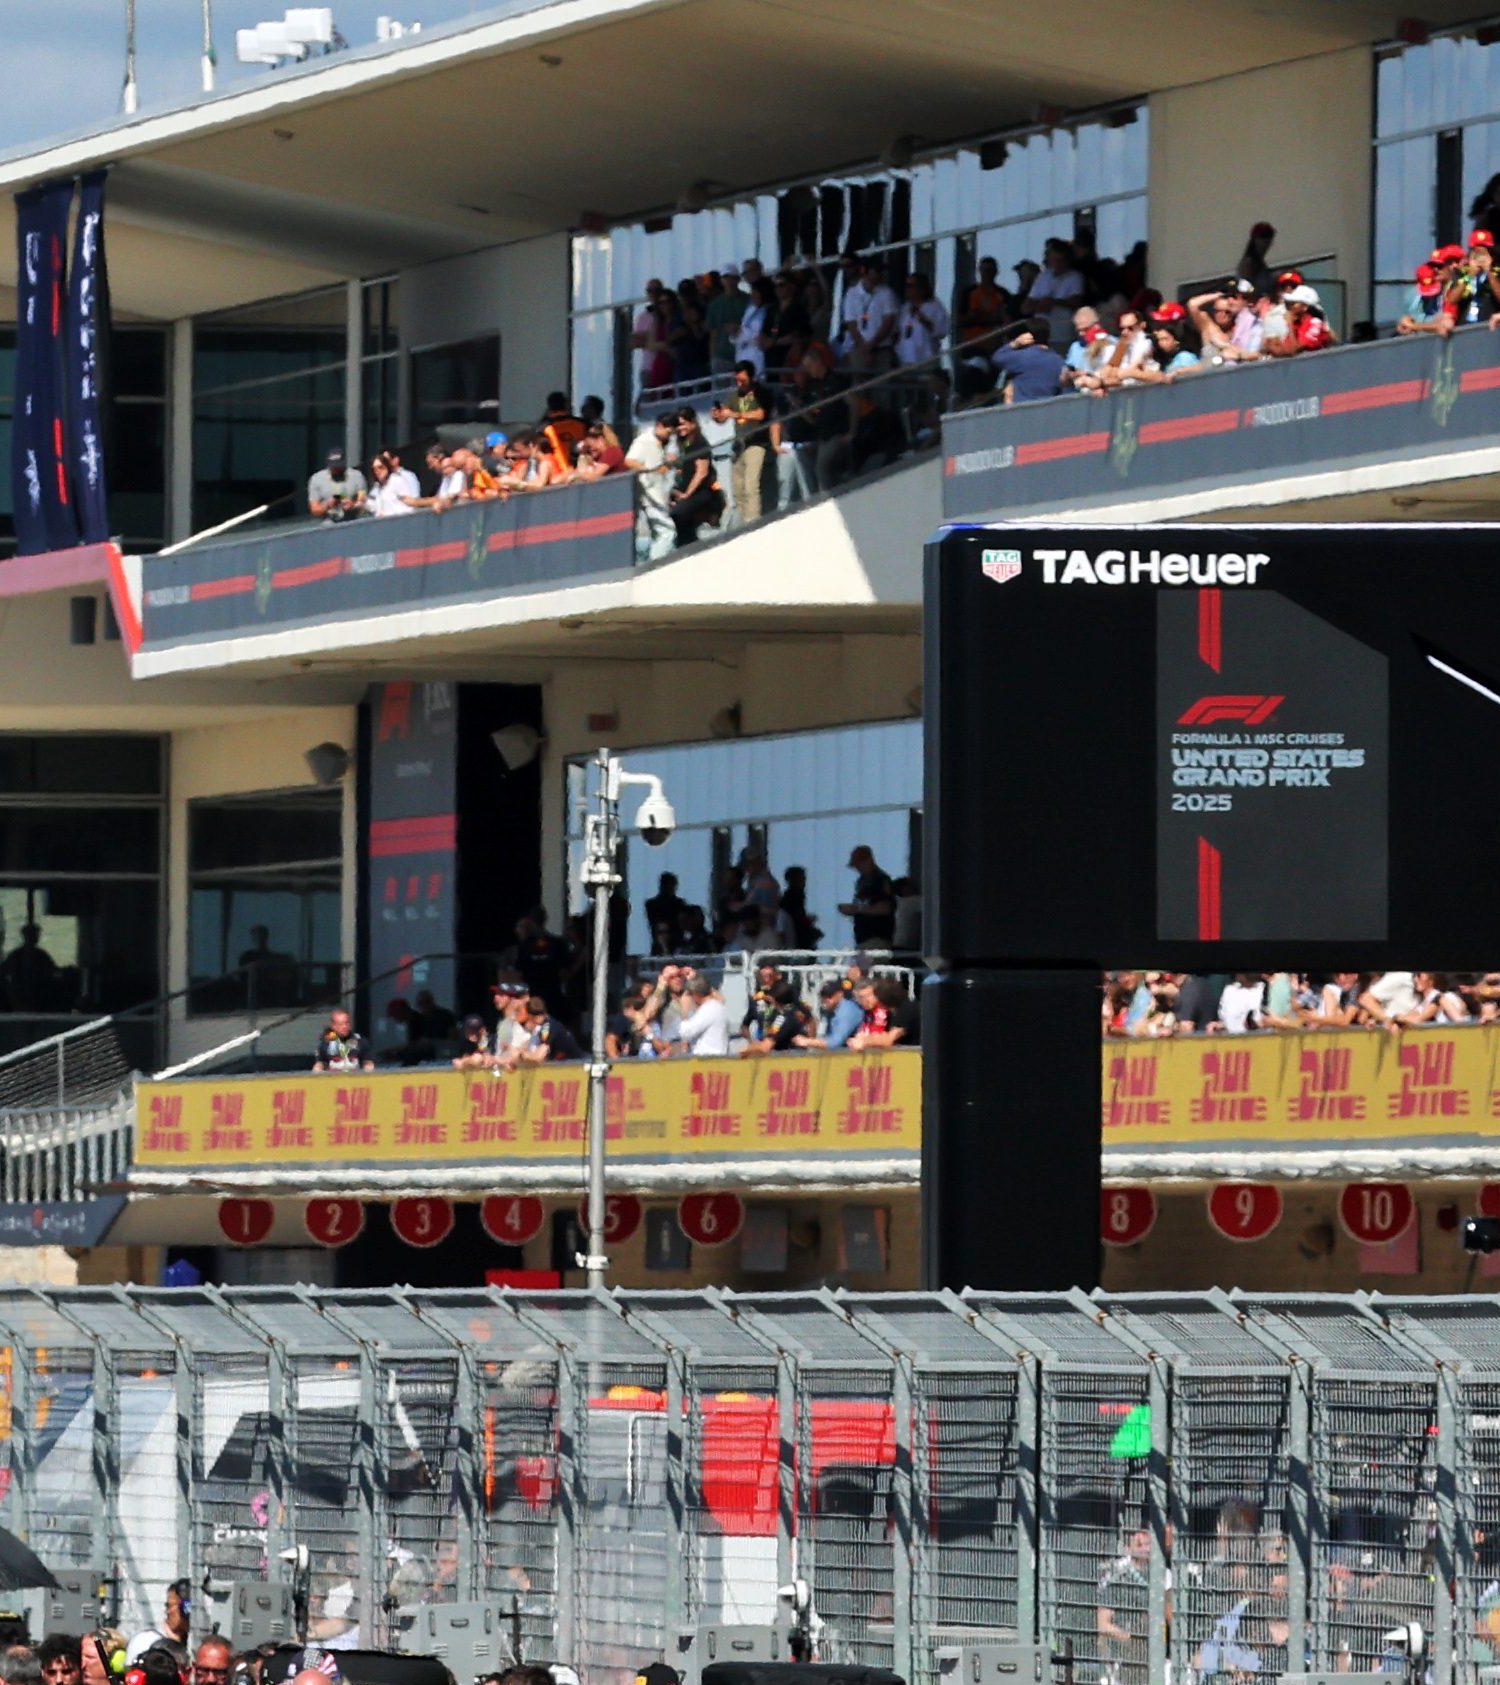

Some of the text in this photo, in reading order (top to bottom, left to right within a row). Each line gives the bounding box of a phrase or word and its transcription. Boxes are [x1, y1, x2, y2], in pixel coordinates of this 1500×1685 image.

[1172, 733, 1241, 746] FORMULA
[1255, 734, 1285, 746] MSC
[1287, 733, 1345, 746] CRUISES
[1172, 749, 1366, 769] UNITED STATES
[1172, 769, 1332, 787] GRAND PRIX
[1171, 794, 1233, 812] 2025
[238, 1206, 248, 1235] 1
[326, 1202, 342, 1236] 2
[415, 1203, 431, 1235] 3
[504, 1201, 522, 1231] 4
[703, 1201, 718, 1234] 6
[1110, 1197, 1130, 1232] 8
[1236, 1190, 1257, 1227] 9
[1361, 1189, 1395, 1233] 10
